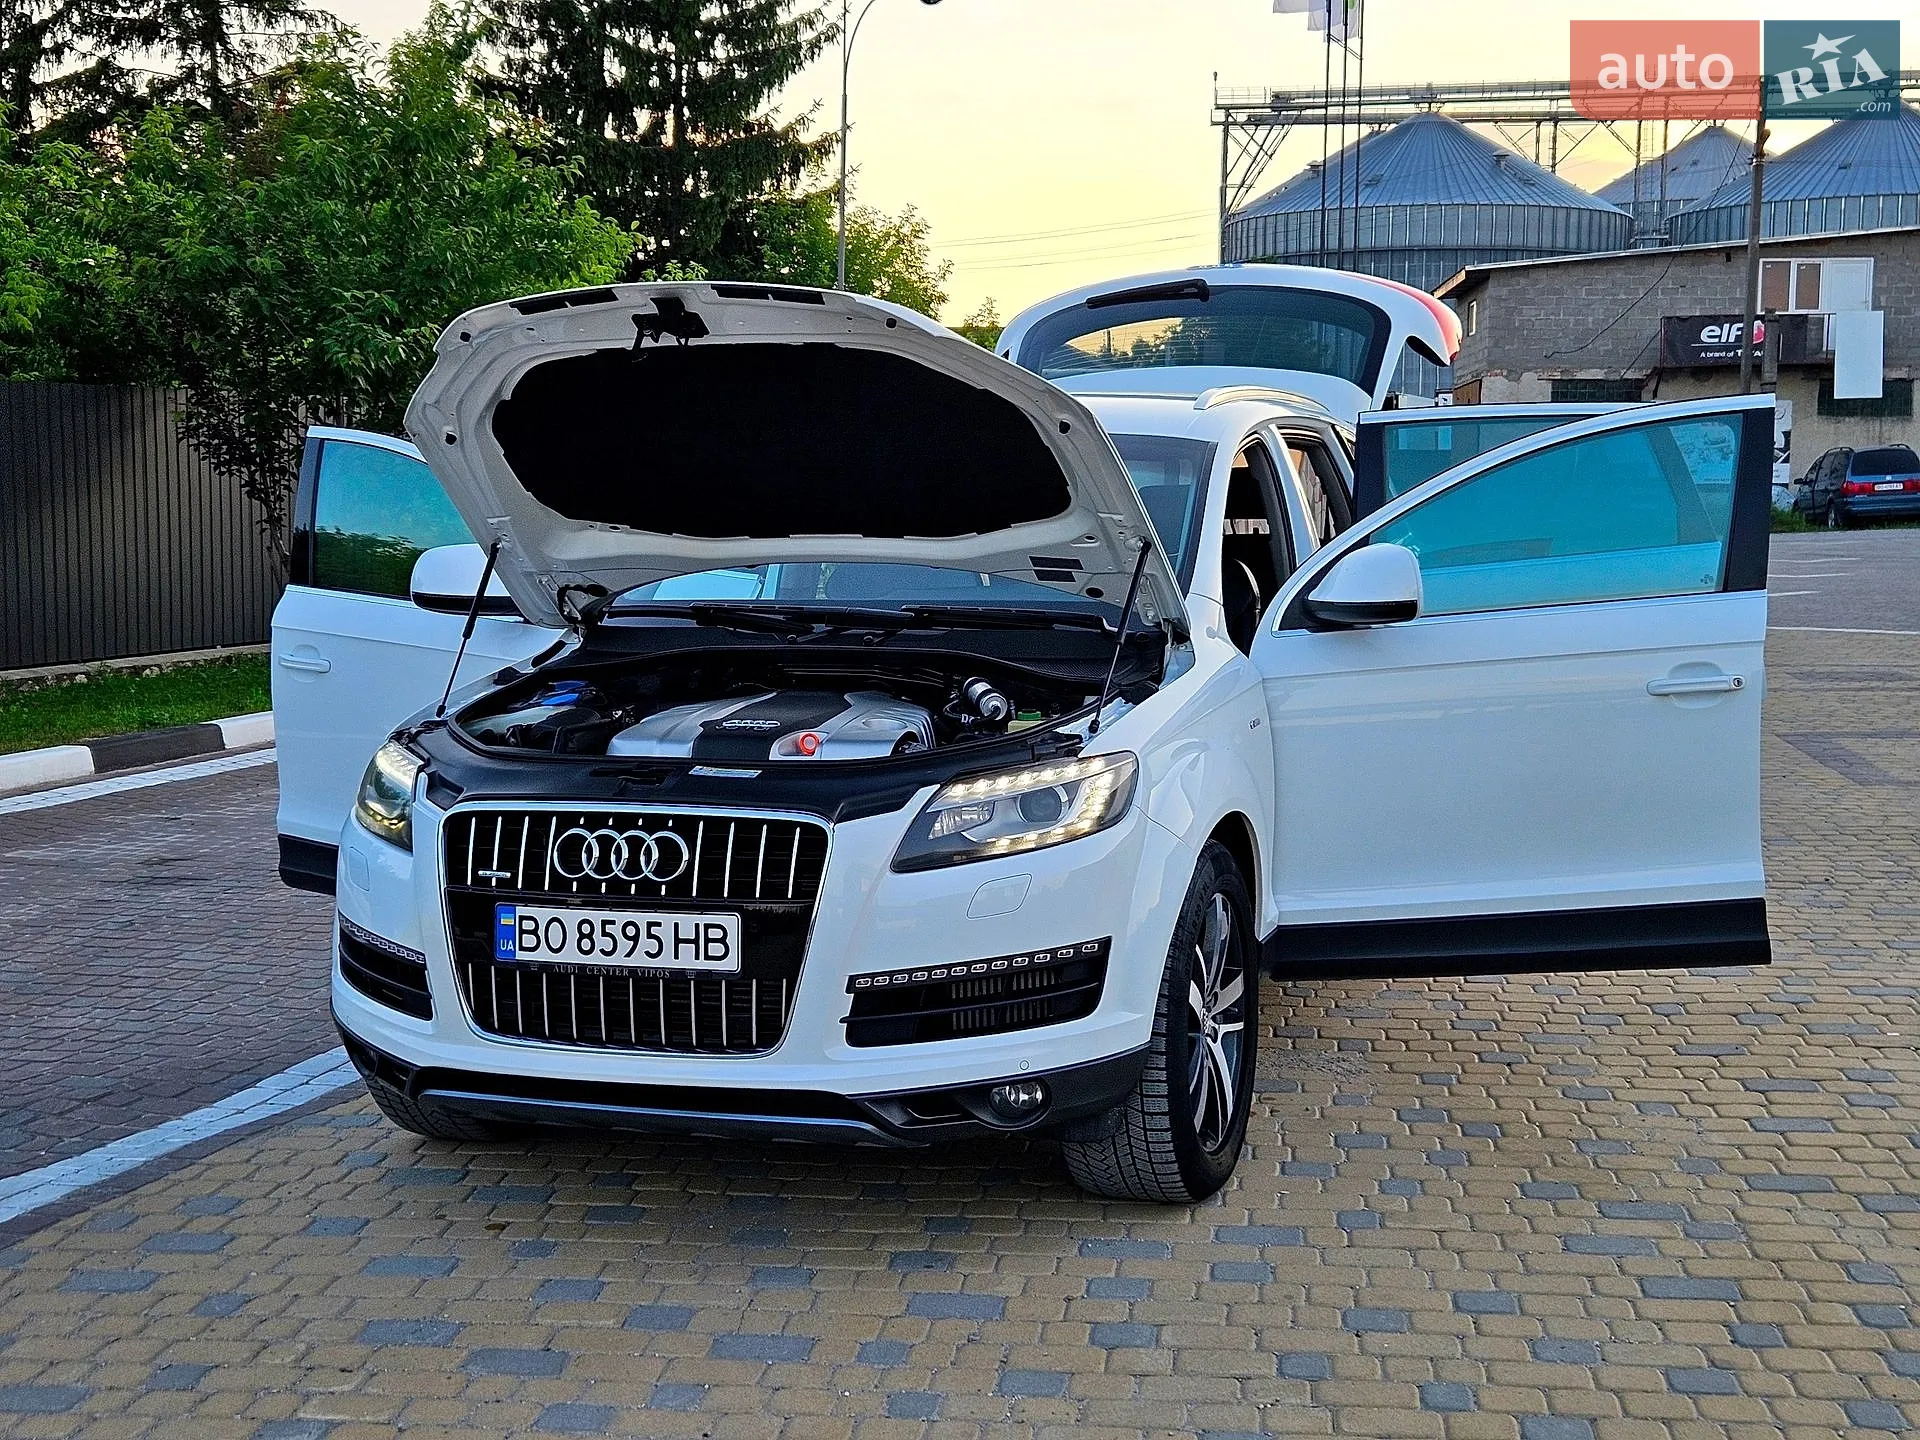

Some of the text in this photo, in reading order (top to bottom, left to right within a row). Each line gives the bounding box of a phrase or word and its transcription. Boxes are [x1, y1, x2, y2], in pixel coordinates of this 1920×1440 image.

[1700, 323, 1744, 343] elf
[500, 939, 515, 951] UA
[576, 918, 664, 959] 8595
[674, 922, 731, 962] HB
[554, 965, 671, 978] AUDI CENTER VIPOS
